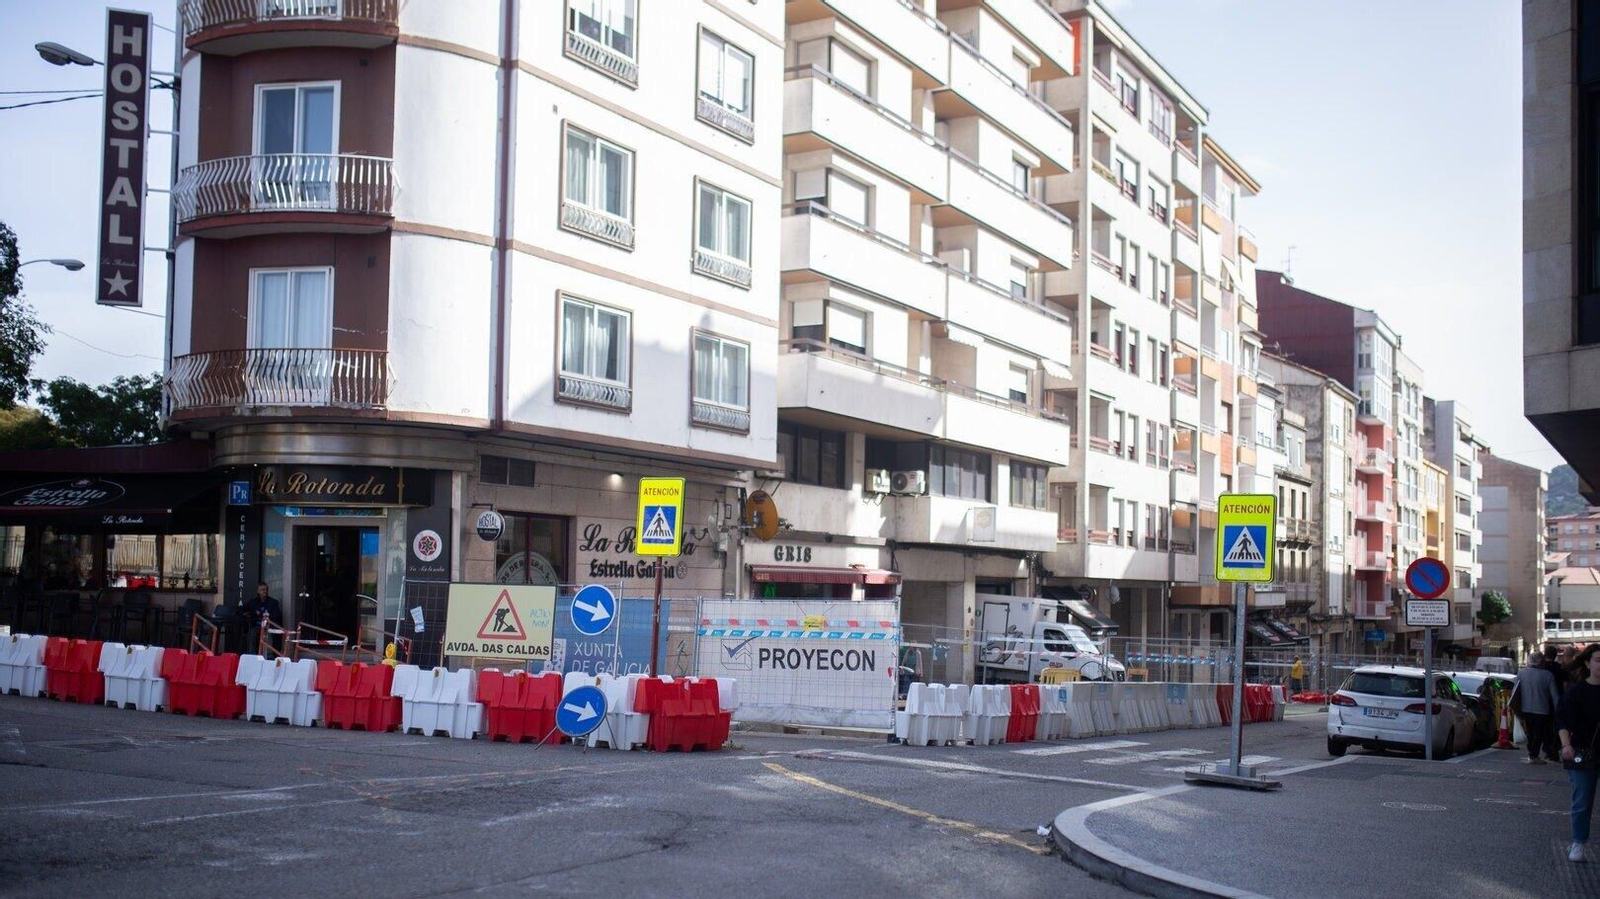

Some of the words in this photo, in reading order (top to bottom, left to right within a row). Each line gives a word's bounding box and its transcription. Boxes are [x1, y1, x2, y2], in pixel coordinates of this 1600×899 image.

[105, 24, 143, 245] HOSTAL
[258, 470, 276, 495] La
[281, 471, 386, 496] Rotonda
[24, 488, 107, 500] Estrella
[643, 487, 680, 497] ATENCIÓN
[1223, 504, 1271, 514] ATENCIÓN
[478, 513, 498, 528] HOSTAL
[579, 523, 613, 553] La
[237, 515, 246, 607] CERVECERÍA
[774, 545, 812, 563] GRIS
[589, 559, 635, 578] Estrella
[636, 560, 675, 578] Galia
[446, 642, 478, 653] AVDA.
[481, 644, 504, 654] DAS
[506, 645, 550, 656] CALDAS
[574, 642, 623, 658] XUNTA
[572, 660, 590, 673] DE
[594, 661, 652, 677] GALICIA
[758, 648, 876, 672] PROYECON
